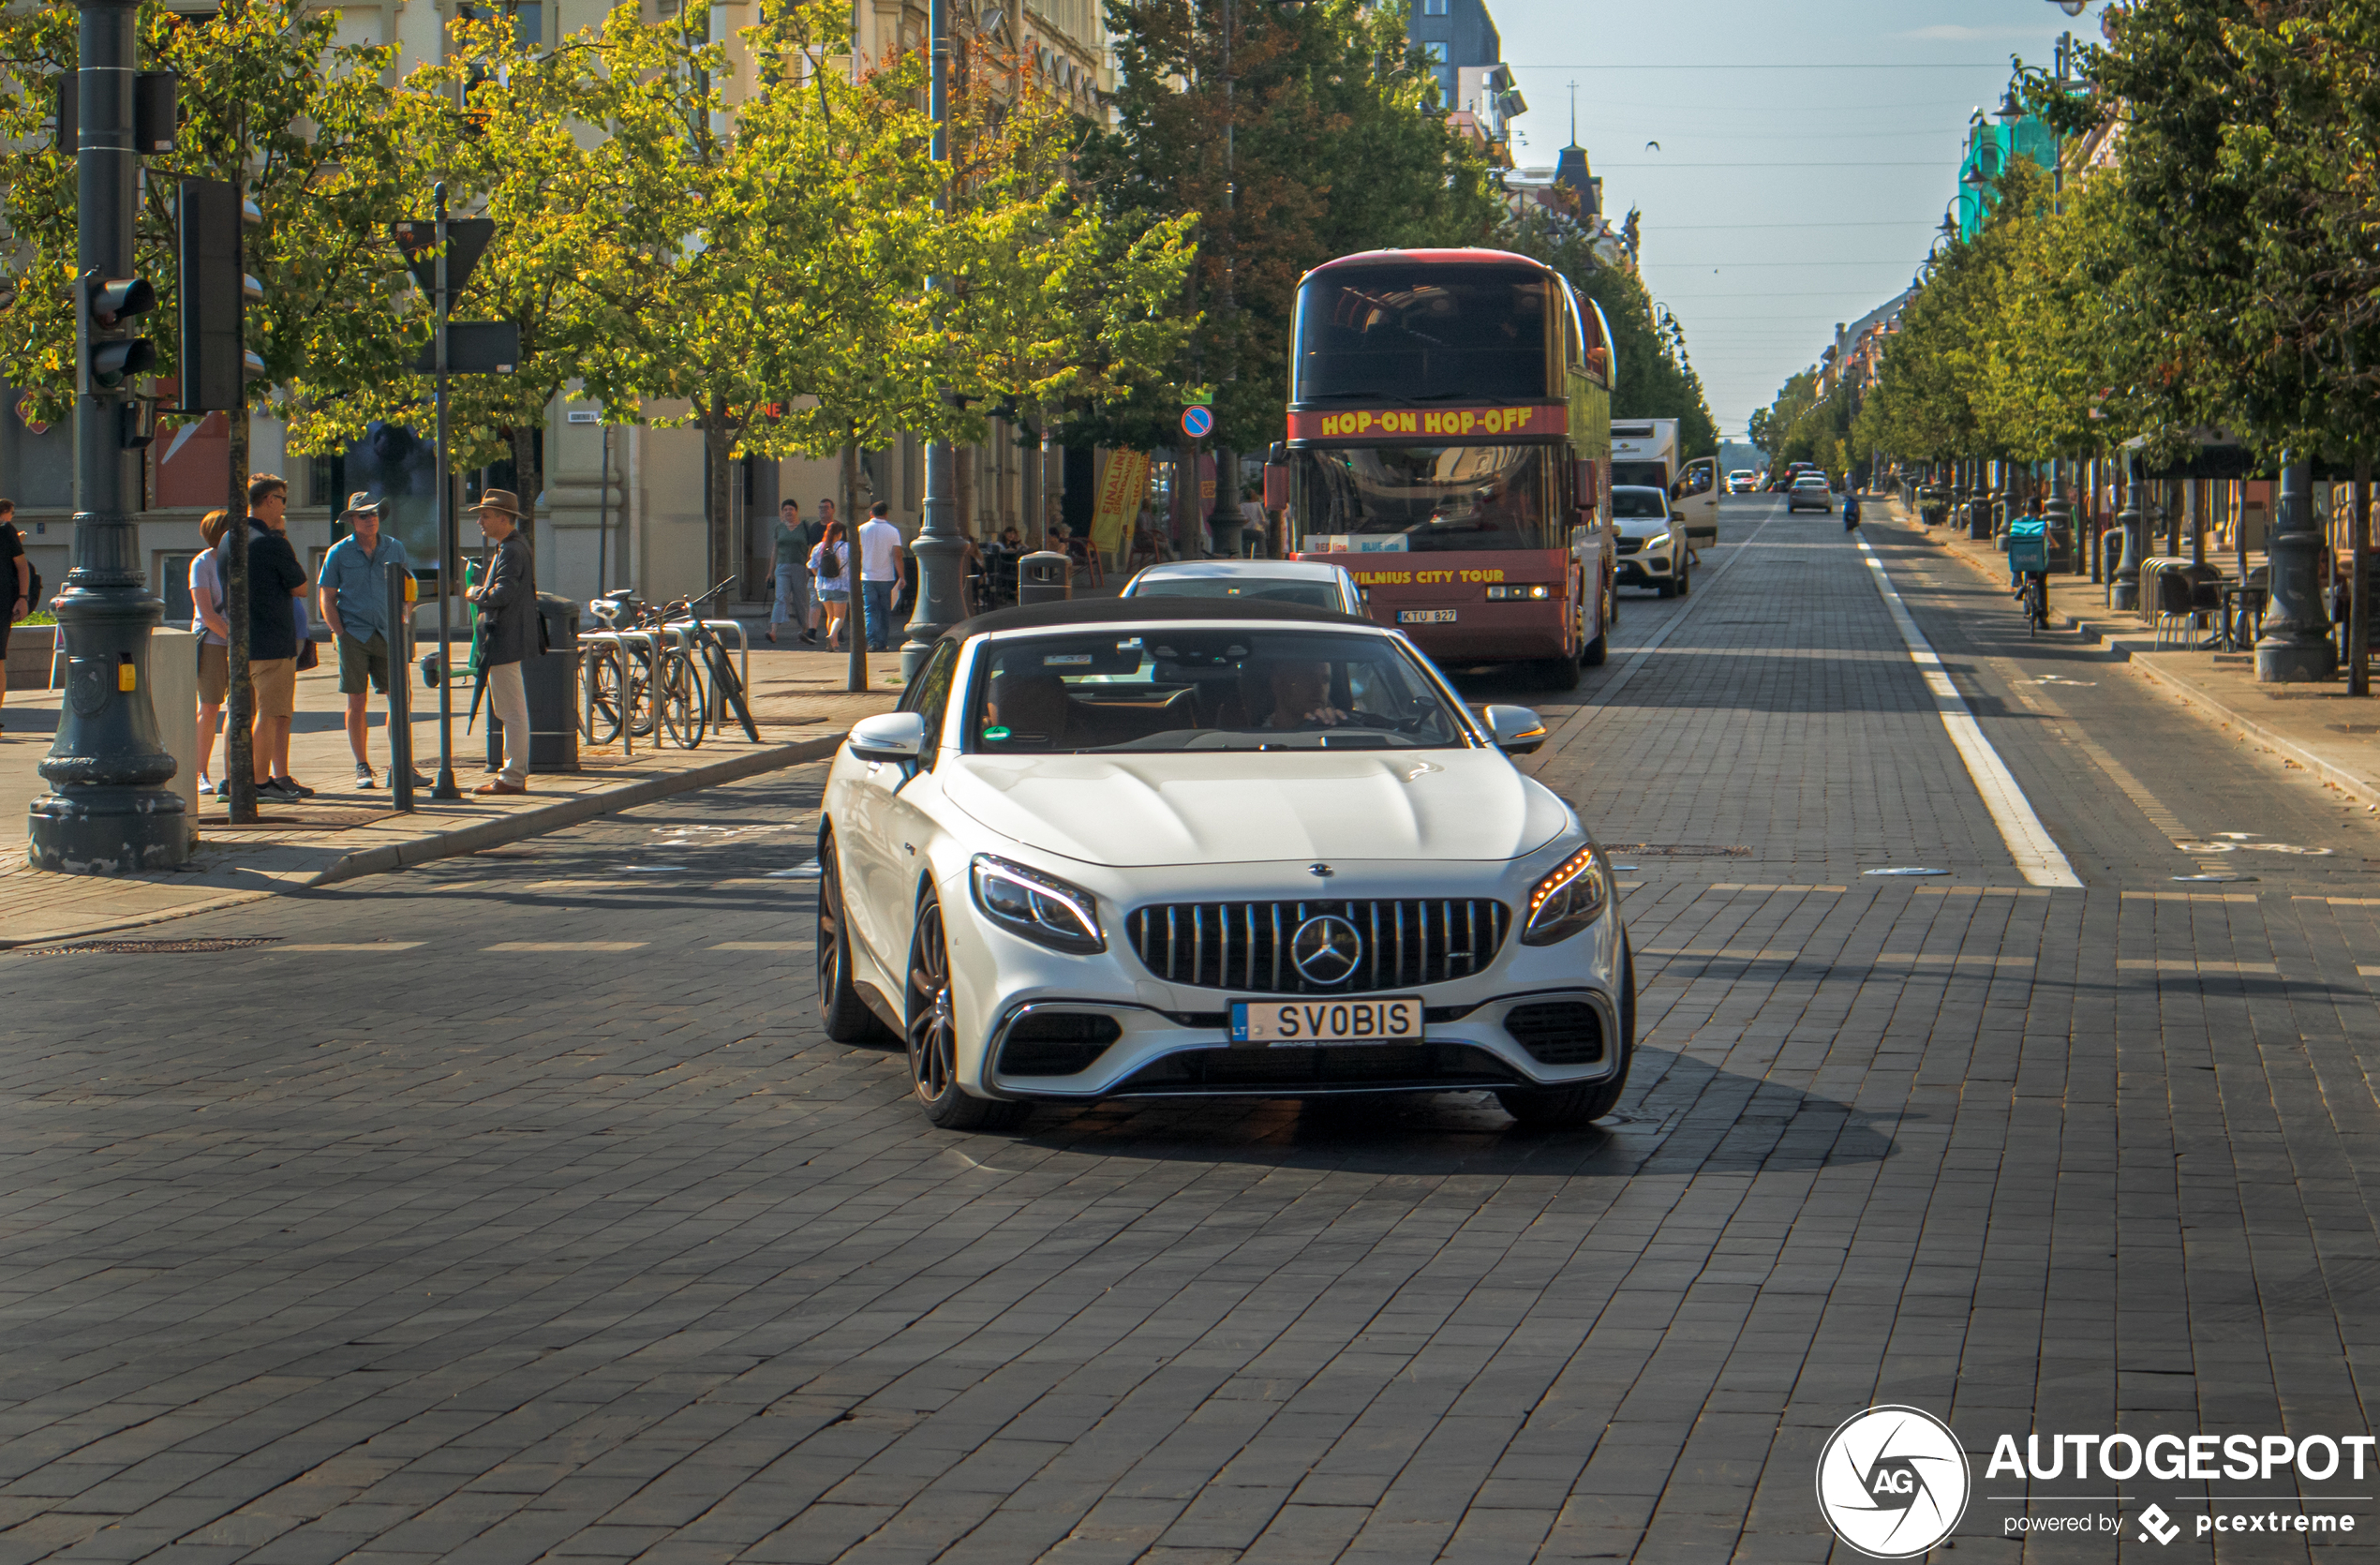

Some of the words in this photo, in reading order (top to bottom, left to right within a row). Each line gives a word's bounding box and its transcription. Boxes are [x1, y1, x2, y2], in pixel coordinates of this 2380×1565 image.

[1322, 411, 1417, 435] HOP-ON
[1424, 407, 1532, 434] HOP-OFF
[1315, 543, 1330, 552] RED
[1332, 542, 1346, 552] line
[1361, 542, 1382, 552] BLUE
[1349, 572, 1411, 585] VILNIUS
[1416, 571, 1454, 583] CITY
[1459, 569, 1504, 582] TOUR
[1403, 612, 1427, 621] KTU
[1434, 610, 1454, 620] 827
[1232, 1026, 1247, 1036] LT
